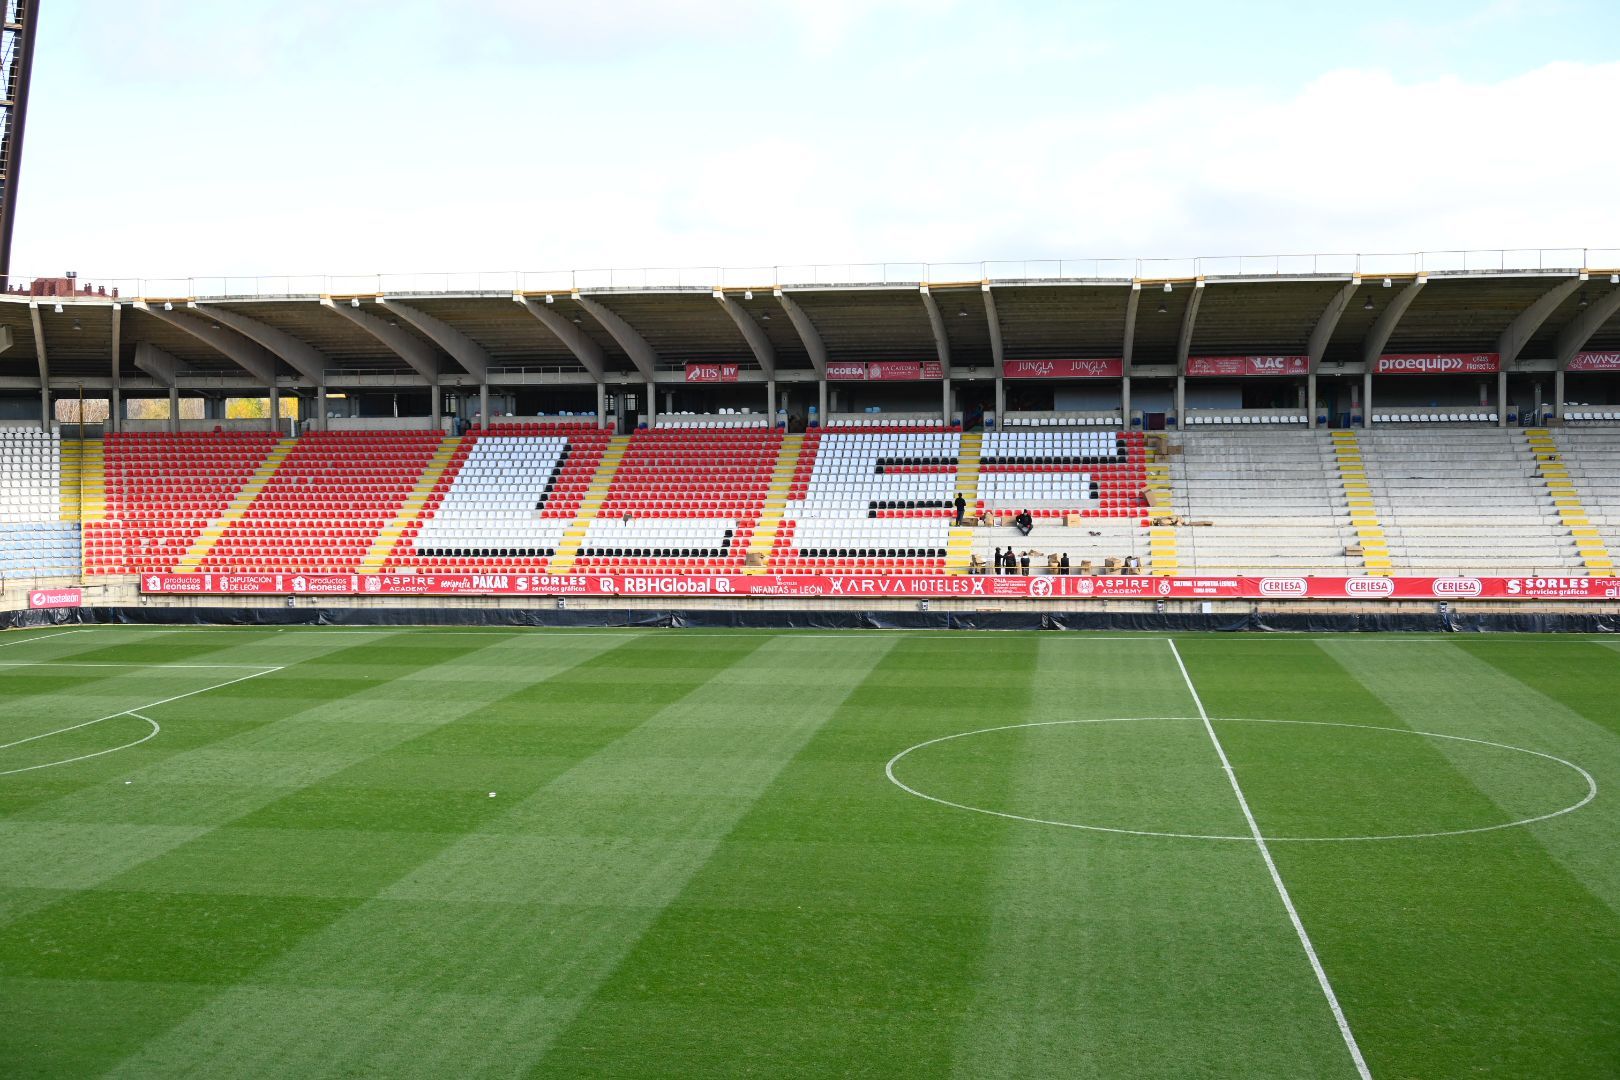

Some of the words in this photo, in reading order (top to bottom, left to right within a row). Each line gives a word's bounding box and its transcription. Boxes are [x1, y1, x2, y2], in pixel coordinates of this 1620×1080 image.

[1256, 357, 1284, 368] LAC
[1379, 355, 1451, 371] proequip
[164, 576, 201, 585] productos
[229, 575, 272, 583] DIPUTACIÓN
[309, 577, 347, 585] productos
[383, 576, 435, 584] ASPIRE
[473, 576, 509, 589] PAKAR
[532, 577, 587, 586] SORLES
[1096, 578, 1149, 587] ASPIRE
[1525, 579, 1589, 588] SORLES
[229, 583, 240, 591] DE
[241, 582, 259, 591] LEÓN
[560, 585, 586, 593] gráficos
[625, 577, 710, 593] RBHGlobal
[750, 585, 789, 594] INFANTAS
[800, 584, 823, 594] LEÓN
[847, 580, 906, 592] ARVA
[912, 580, 968, 592] HOTELES
[1263, 580, 1302, 592] CERLESA
[1349, 579, 1388, 592] CERLESA
[1436, 579, 1476, 592] CERLESA
[1559, 587, 1588, 596] gráficos
